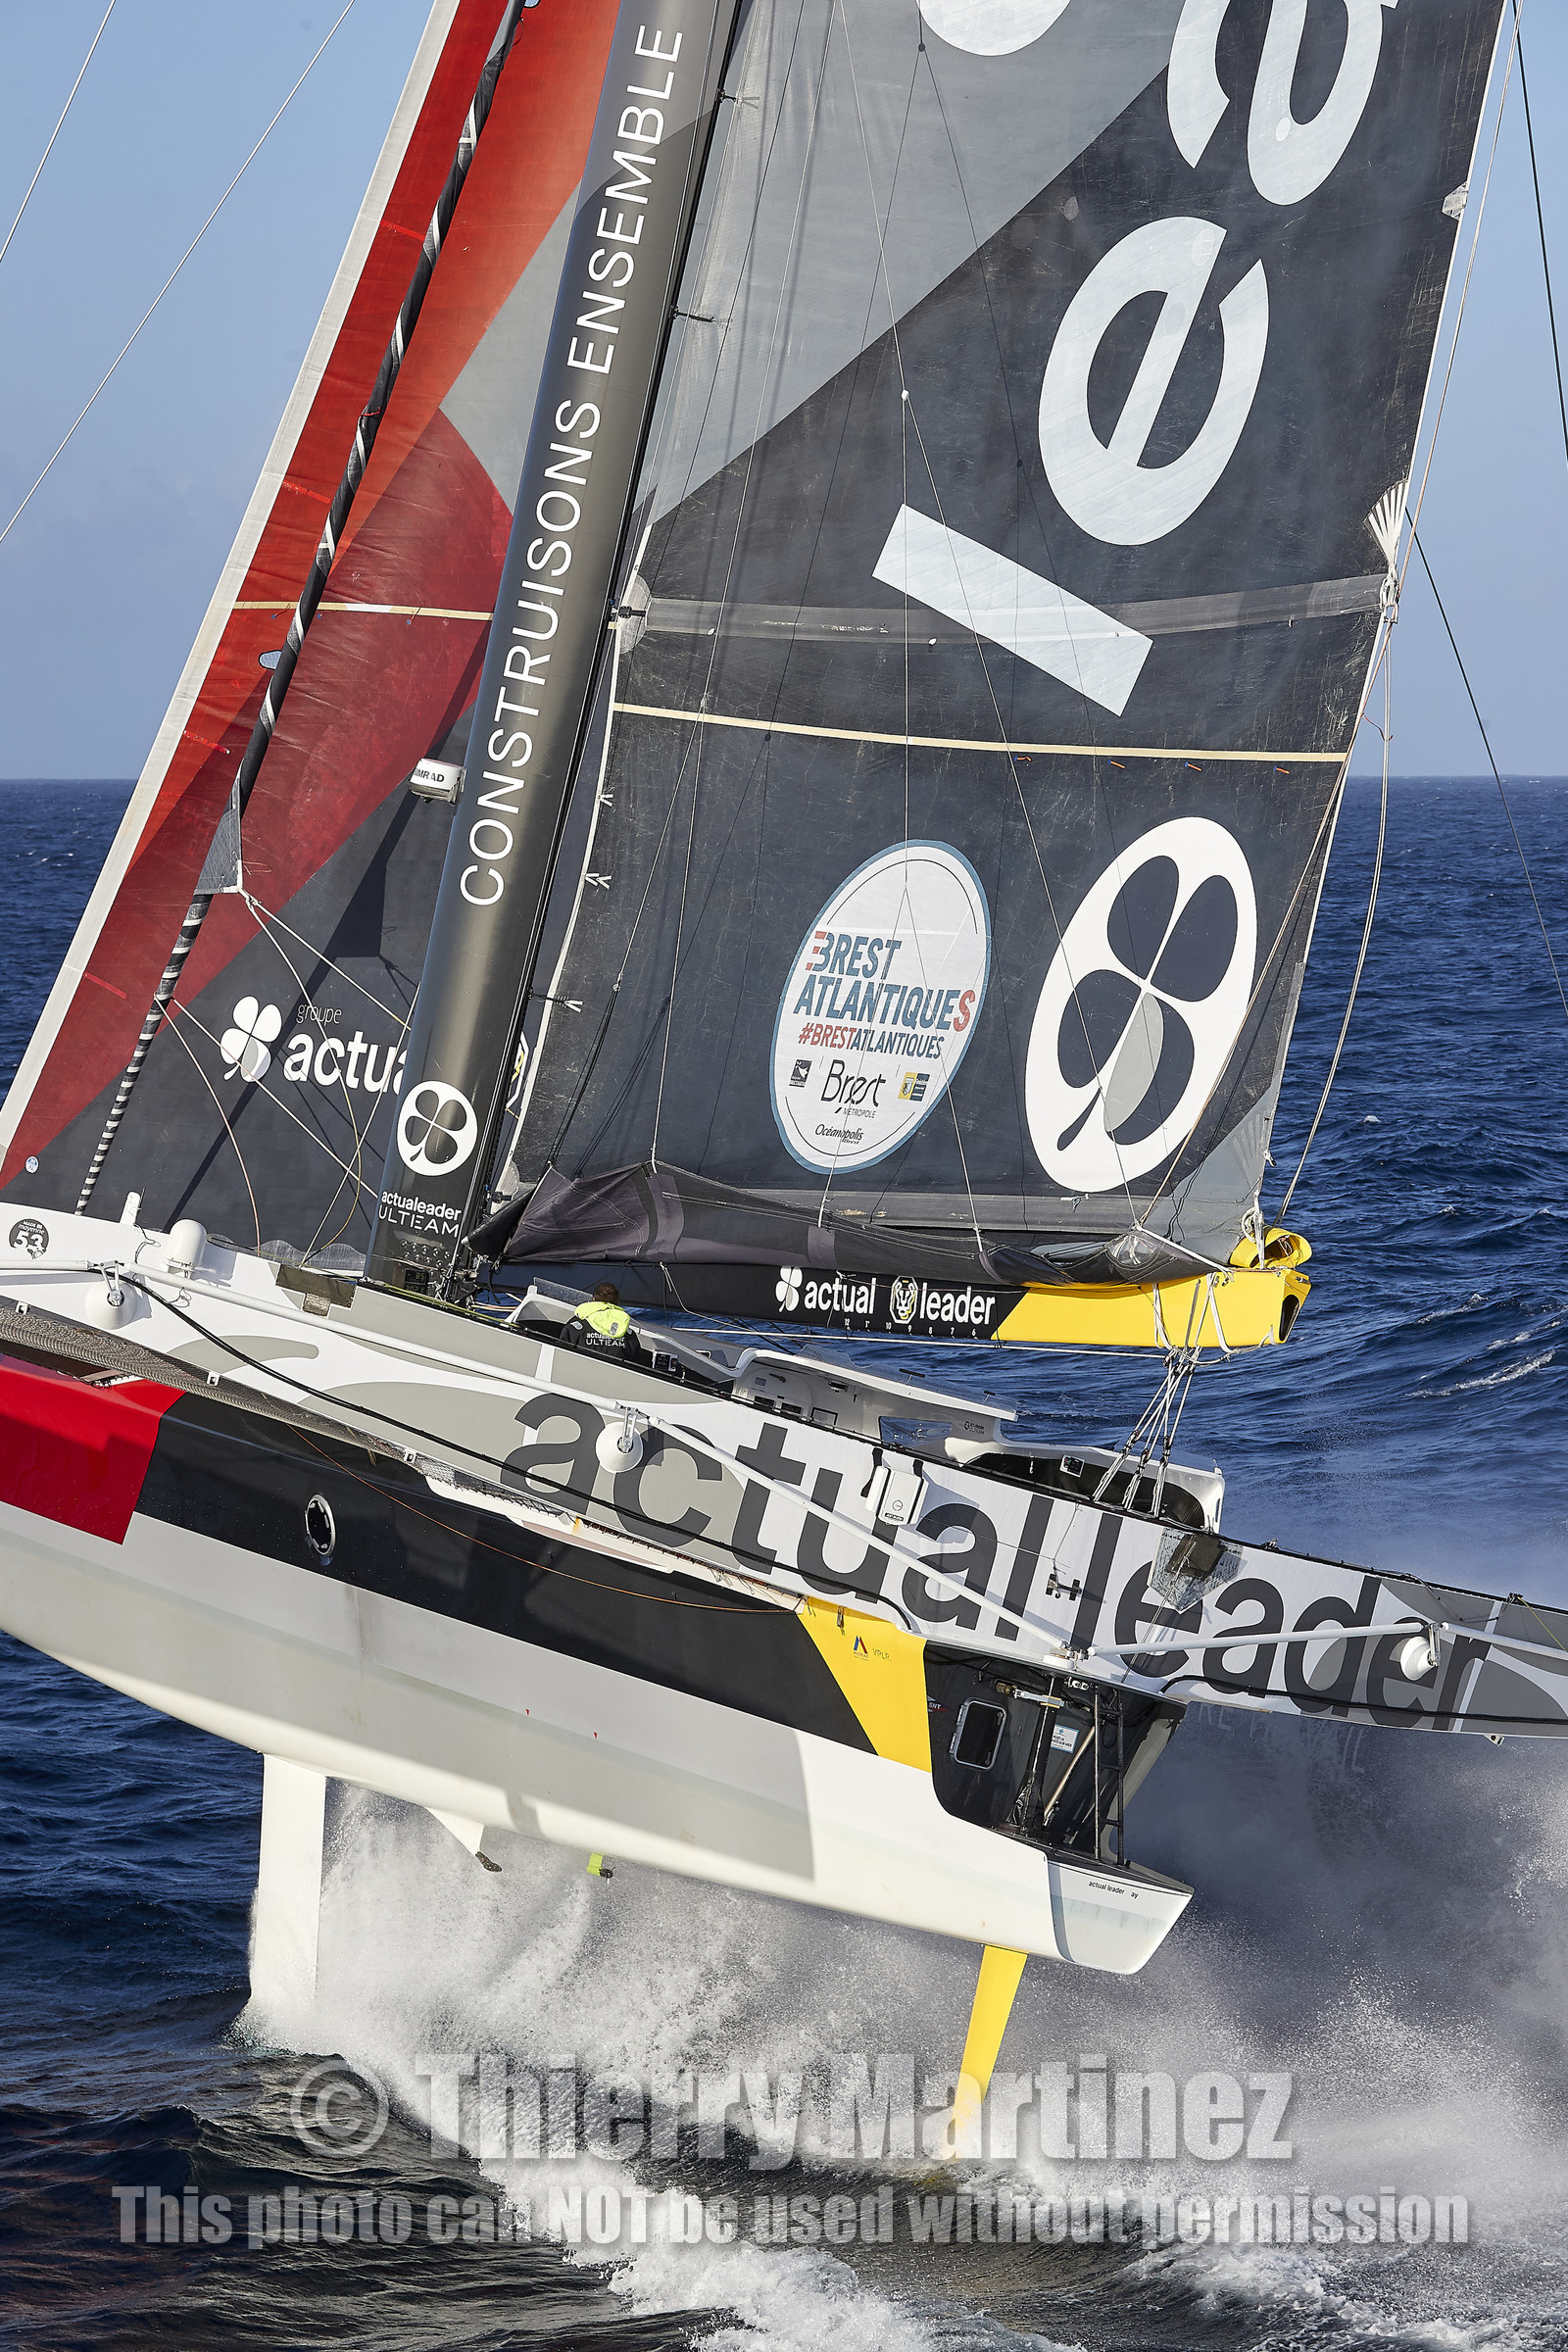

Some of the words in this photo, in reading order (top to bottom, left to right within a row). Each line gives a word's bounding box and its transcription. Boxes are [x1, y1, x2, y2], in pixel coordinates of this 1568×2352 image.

[460, 399, 601, 906] CONSTRUISONS
[566, 24, 683, 374] ENSEMBLE
[806, 930, 903, 980] BREST
[296, 1004, 342, 1026] groupe
[793, 973, 976, 1032] ATLANTIQUES
[798, 1022, 946, 1059] #BRESTATLANTIQUES
[820, 1059, 887, 1107] Brest
[815, 1123, 863, 1140] Océanopolis
[378, 1204, 460, 1238] ULTEAM
[381, 1191, 462, 1221] actualeader
[13, 1230, 44, 1251] 53
[804, 1277, 876, 1314] actual
[919, 1282, 996, 1324] leader
[585, 1338, 625, 1348] ULTEAM
[1088, 1881, 1106, 1890] actual
[1107, 1884, 1125, 1894] leader
